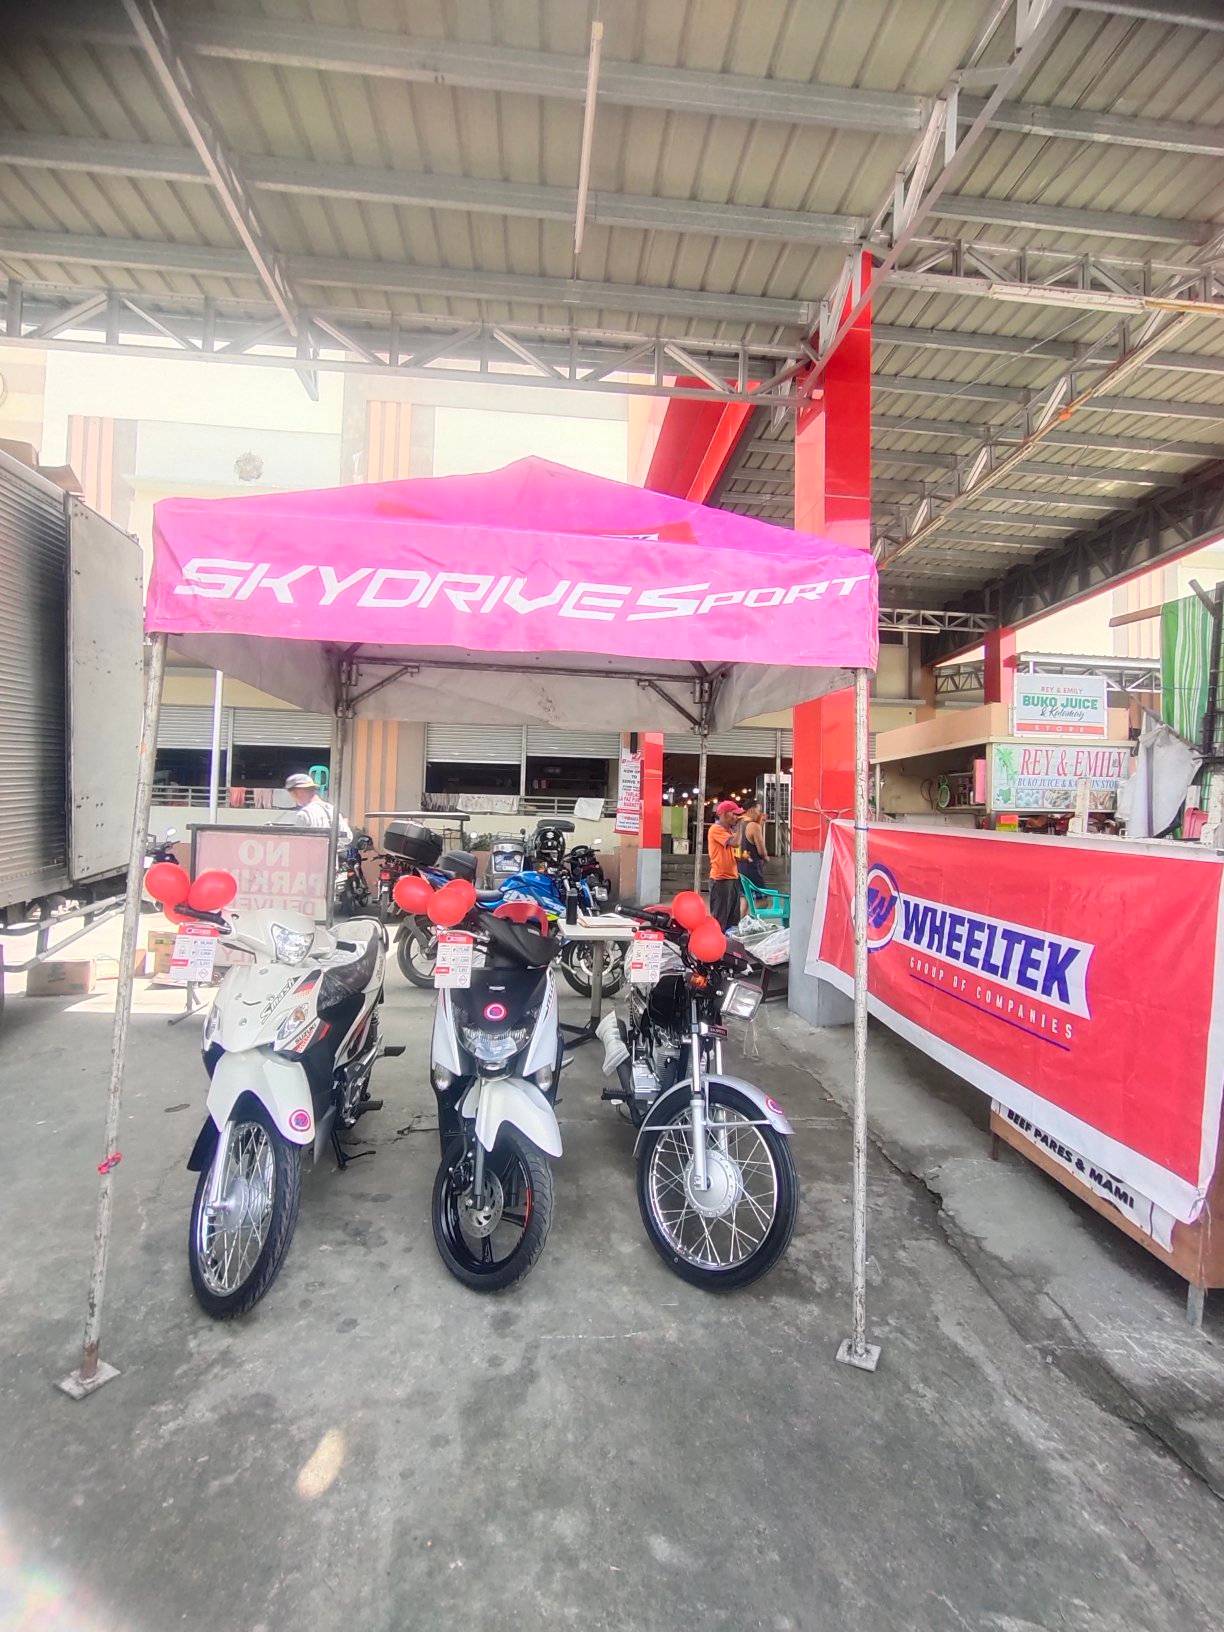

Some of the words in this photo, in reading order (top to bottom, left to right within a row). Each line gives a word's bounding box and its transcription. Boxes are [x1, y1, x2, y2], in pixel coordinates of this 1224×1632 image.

[173, 557, 633, 621] SKYDRIVE
[626, 574, 870, 621] SPORT
[1022, 695, 1058, 707] BUKO
[1060, 697, 1098, 710] JUICE
[1020, 748, 1054, 776] REY
[1056, 750, 1068, 777] &
[1073, 750, 1127, 778] EMILY
[902, 901, 1082, 1006] WHEELTEK
[910, 956, 945, 981] GROUP
[952, 975, 967, 992] OF
[976, 985, 1073, 1040] COMPANIES
[1006, 1108, 1033, 1132] BEEF
[1033, 1127, 1073, 1163] PARES
[1074, 1157, 1086, 1173] &
[1088, 1167, 1135, 1210] MAMI
